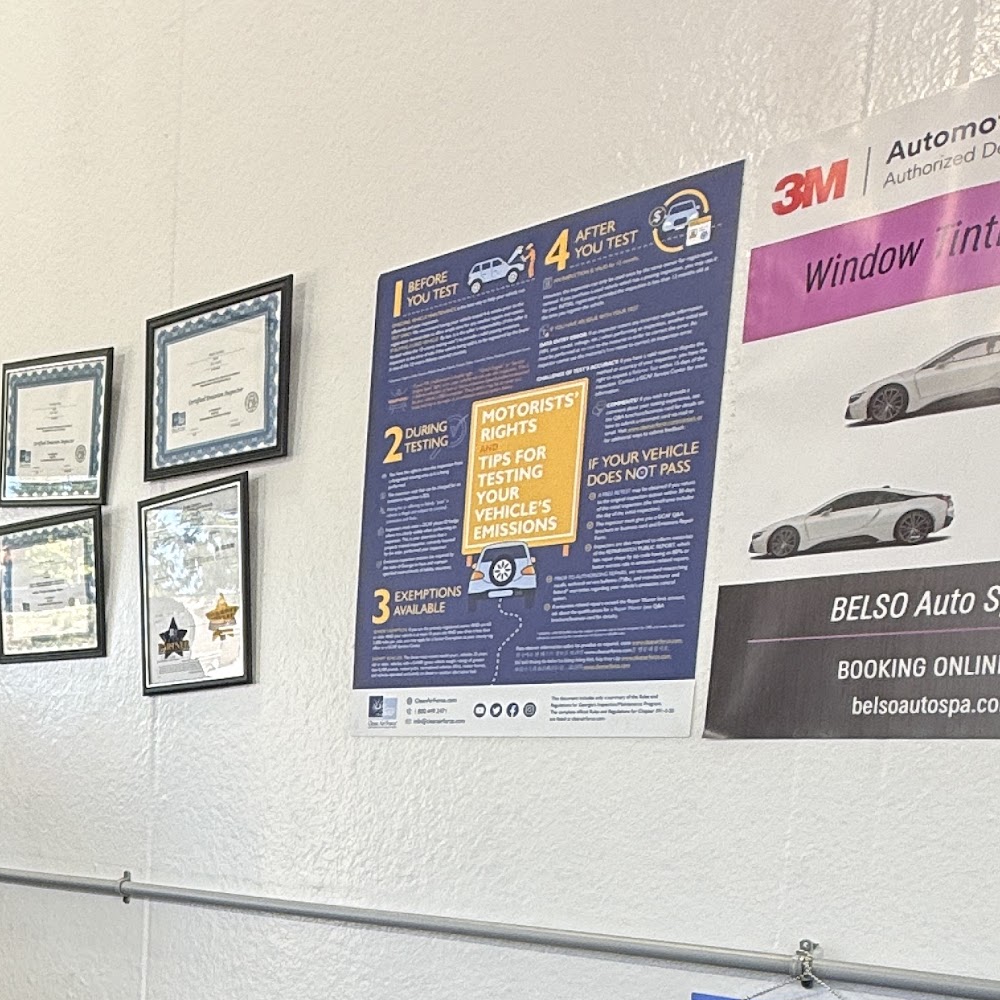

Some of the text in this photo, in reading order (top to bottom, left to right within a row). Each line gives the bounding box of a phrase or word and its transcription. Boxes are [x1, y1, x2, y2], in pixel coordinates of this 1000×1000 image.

[886, 115, 1000, 164] Automo
[883, 141, 1000, 188] Authorized D
[771, 158, 849, 216] 3M
[574, 220, 616, 243] AFTER
[544, 228, 571, 272] 4
[574, 229, 639, 259] YOU TEST
[806, 214, 1000, 293] Window Tint
[407, 271, 449, 293] BEFORE
[407, 283, 459, 307] YOU TEST
[481, 391, 580, 424] MOTORISTS'
[405, 421, 448, 439] DURING
[480, 418, 538, 442] RIGHTS
[382, 425, 403, 464] 2
[404, 435, 448, 453] TESTING
[479, 443, 498, 453] AND
[588, 441, 700, 470] IF YOUR VEHICLE
[478, 445, 547, 470] TIPS FOR
[477, 464, 544, 487] TESTING
[587, 459, 691, 487] DOES NOT PASS
[476, 486, 520, 505] YOUR
[475, 499, 552, 522] VEHICLE'S
[473, 516, 558, 540] EMISSIONS
[394, 585, 462, 602] EXEMPTIONS
[830, 584, 1000, 622] BELSO Auto S
[371, 588, 391, 624] 3
[393, 601, 446, 616] AVAILABLE
[837, 655, 1000, 679] BOOKING ONLIN
[852, 695, 1000, 717] belsoautospa.co
